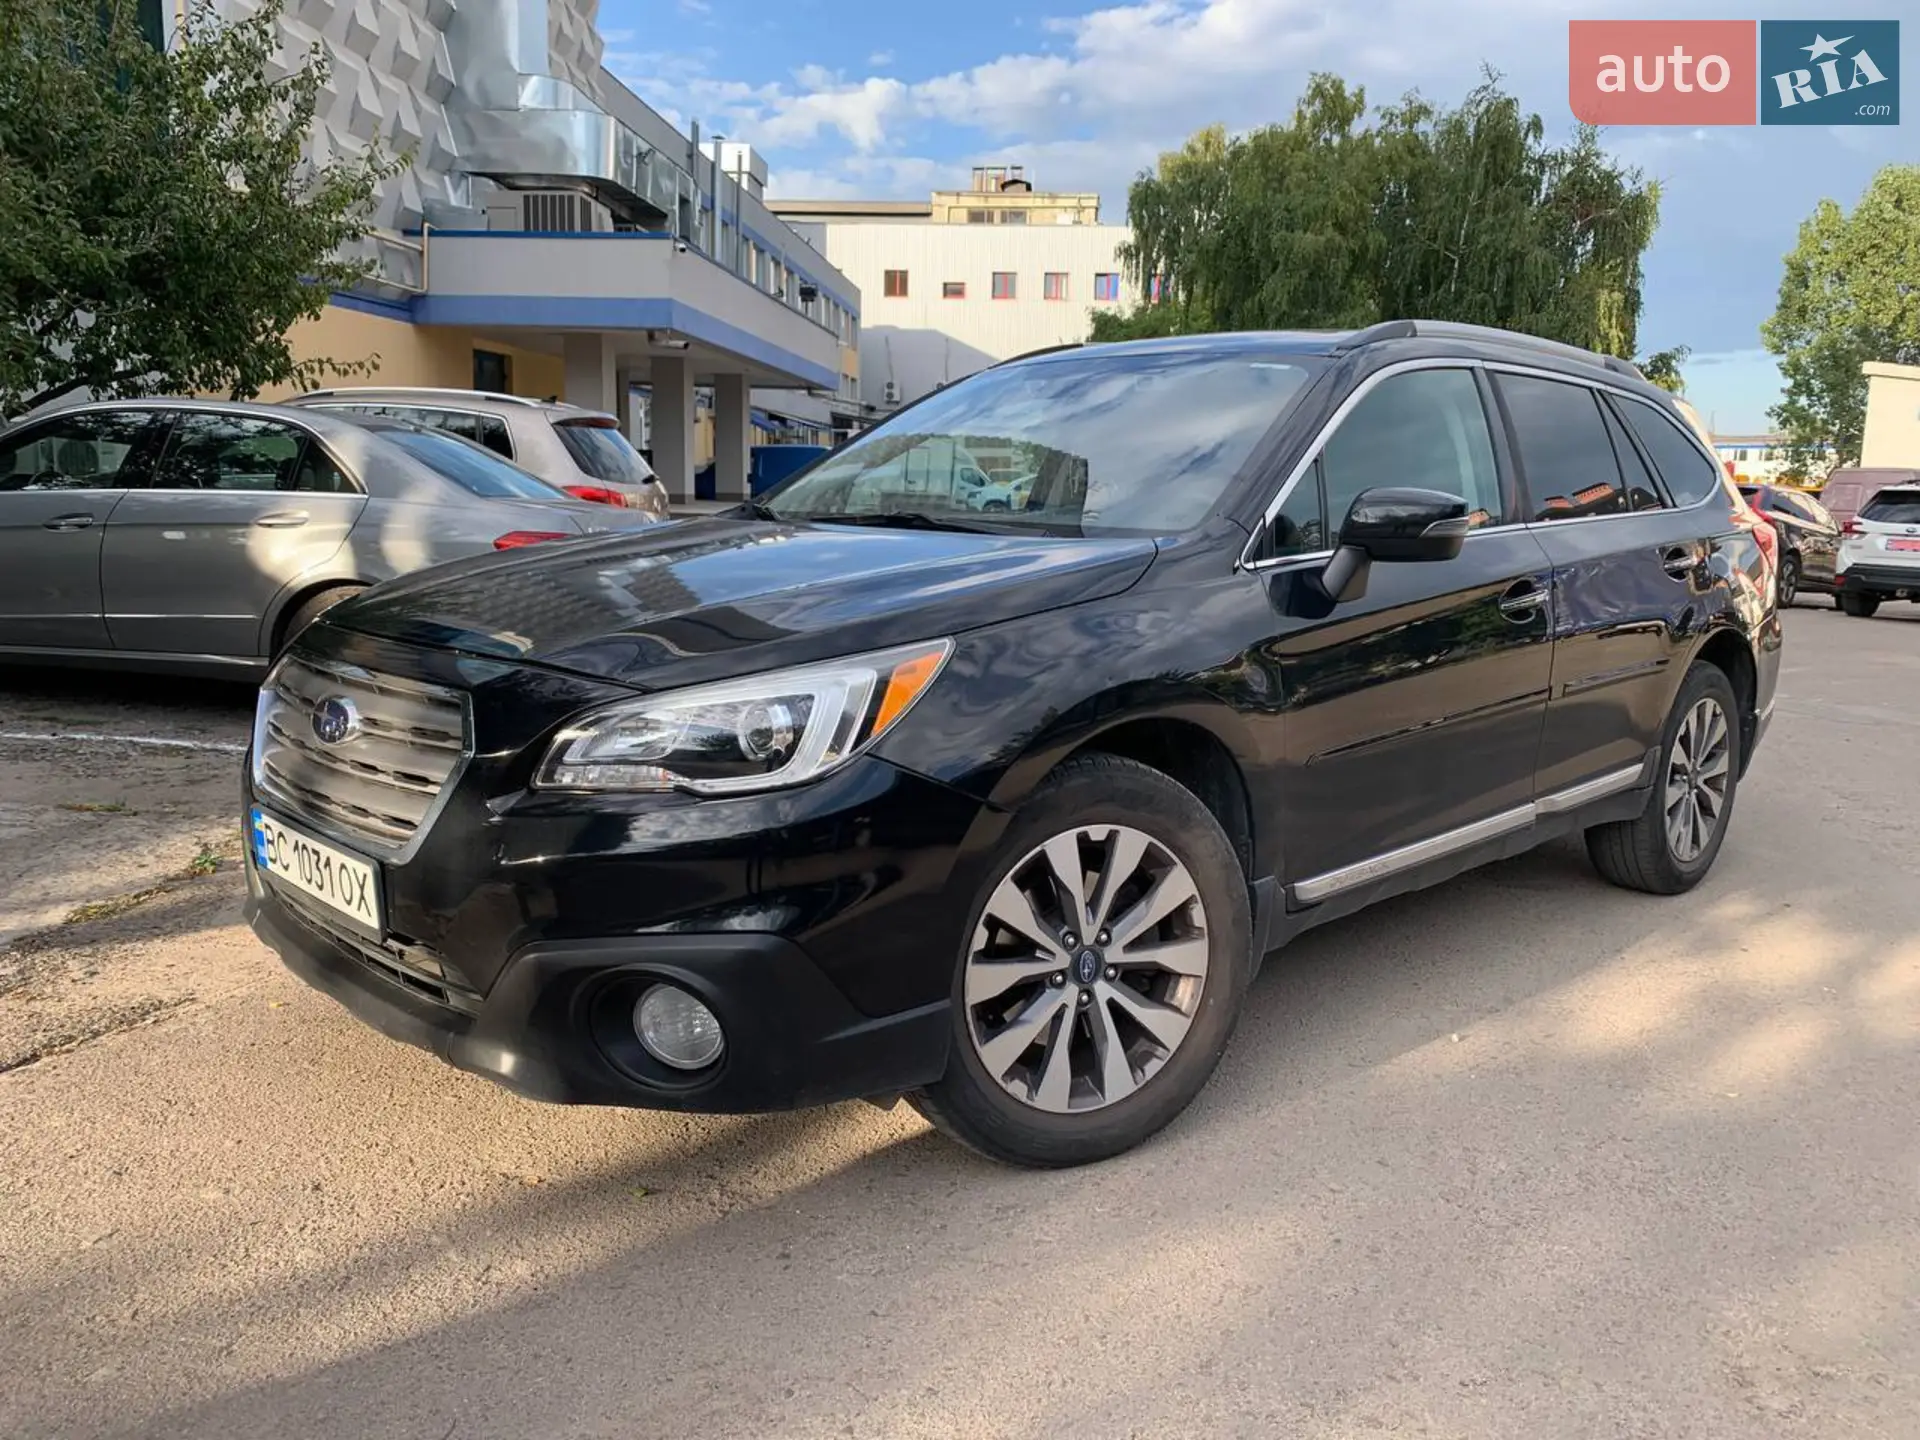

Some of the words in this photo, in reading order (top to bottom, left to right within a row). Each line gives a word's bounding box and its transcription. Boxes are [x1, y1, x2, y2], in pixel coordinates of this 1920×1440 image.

[265, 823, 290, 872] BC
[293, 839, 335, 899] 1031
[339, 862, 371, 917] OX
